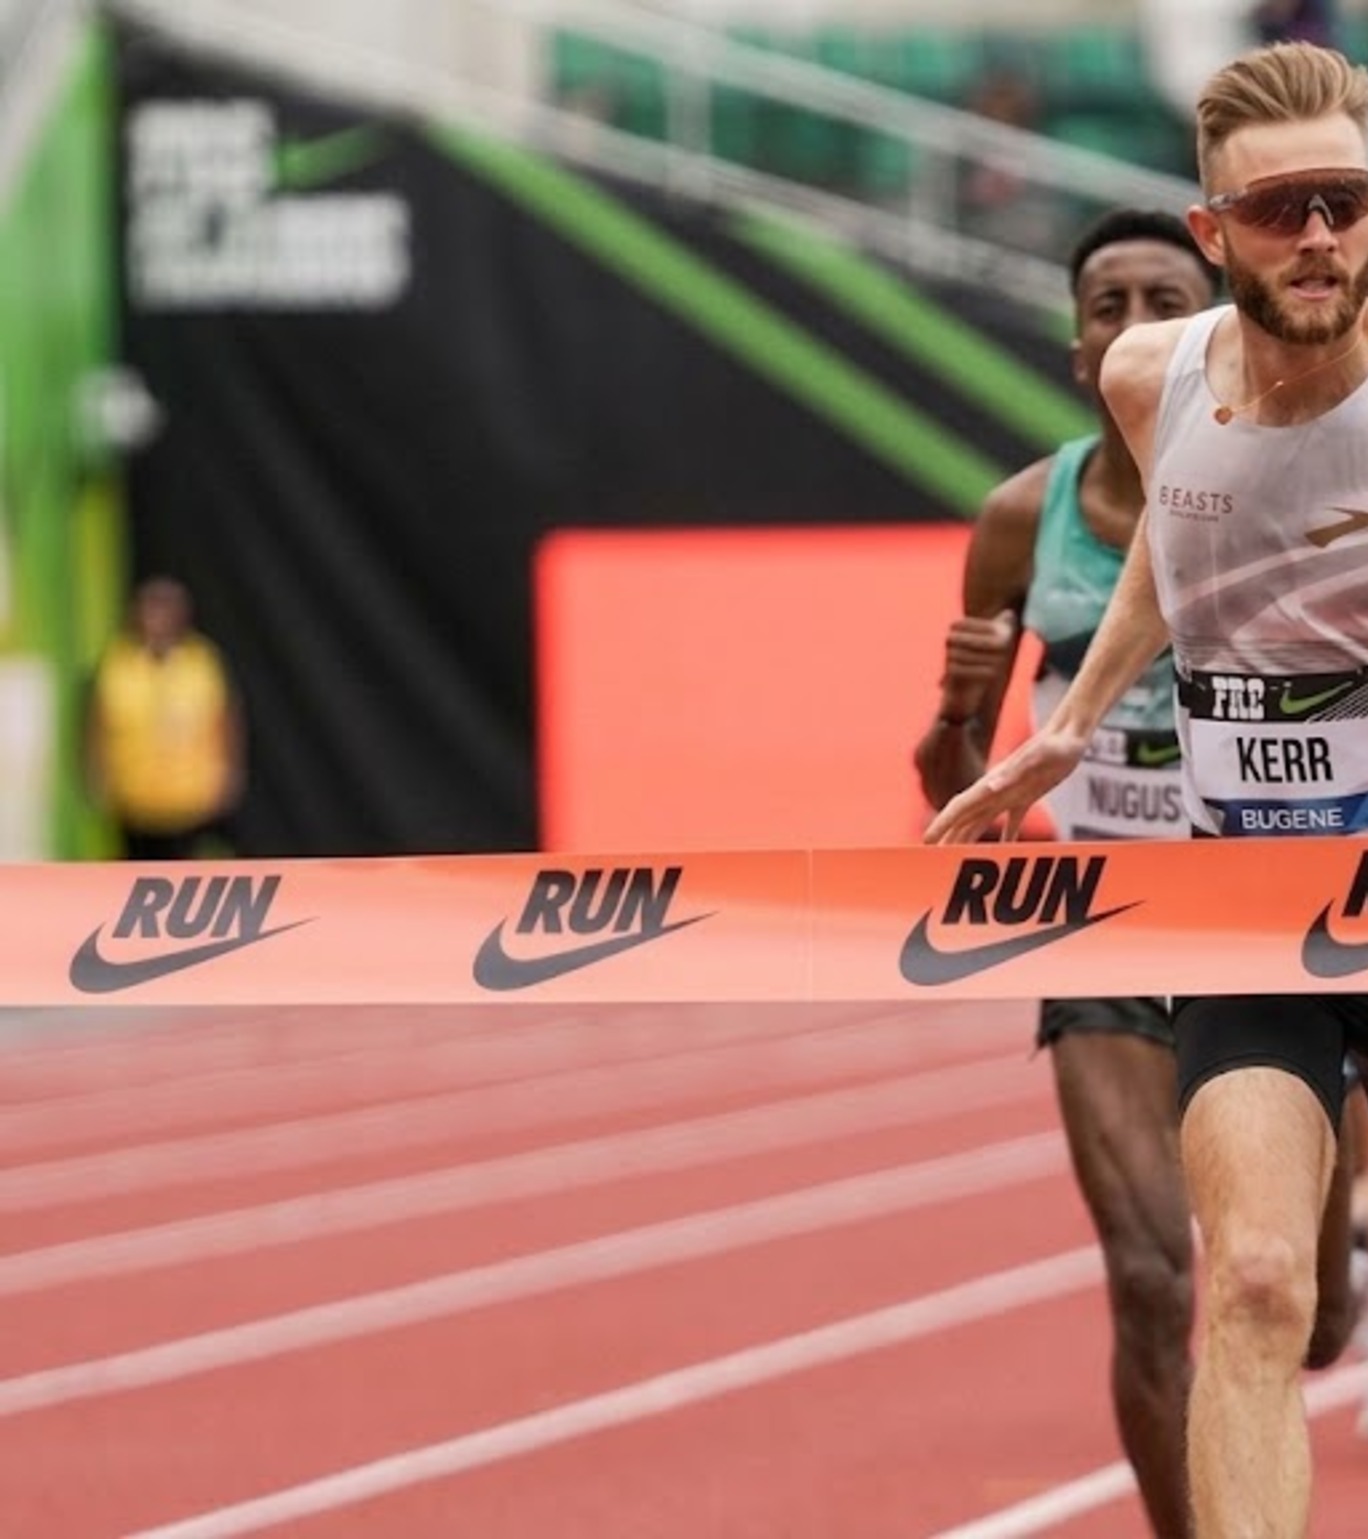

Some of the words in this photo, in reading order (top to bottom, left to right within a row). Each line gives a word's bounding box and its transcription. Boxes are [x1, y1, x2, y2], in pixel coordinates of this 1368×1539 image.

[1159, 484, 1234, 515] BEASTS
[1236, 736, 1334, 784] KERR
[111, 875, 282, 939] RUN
[515, 867, 683, 935] RUN
[941, 856, 1107, 926] RUN
